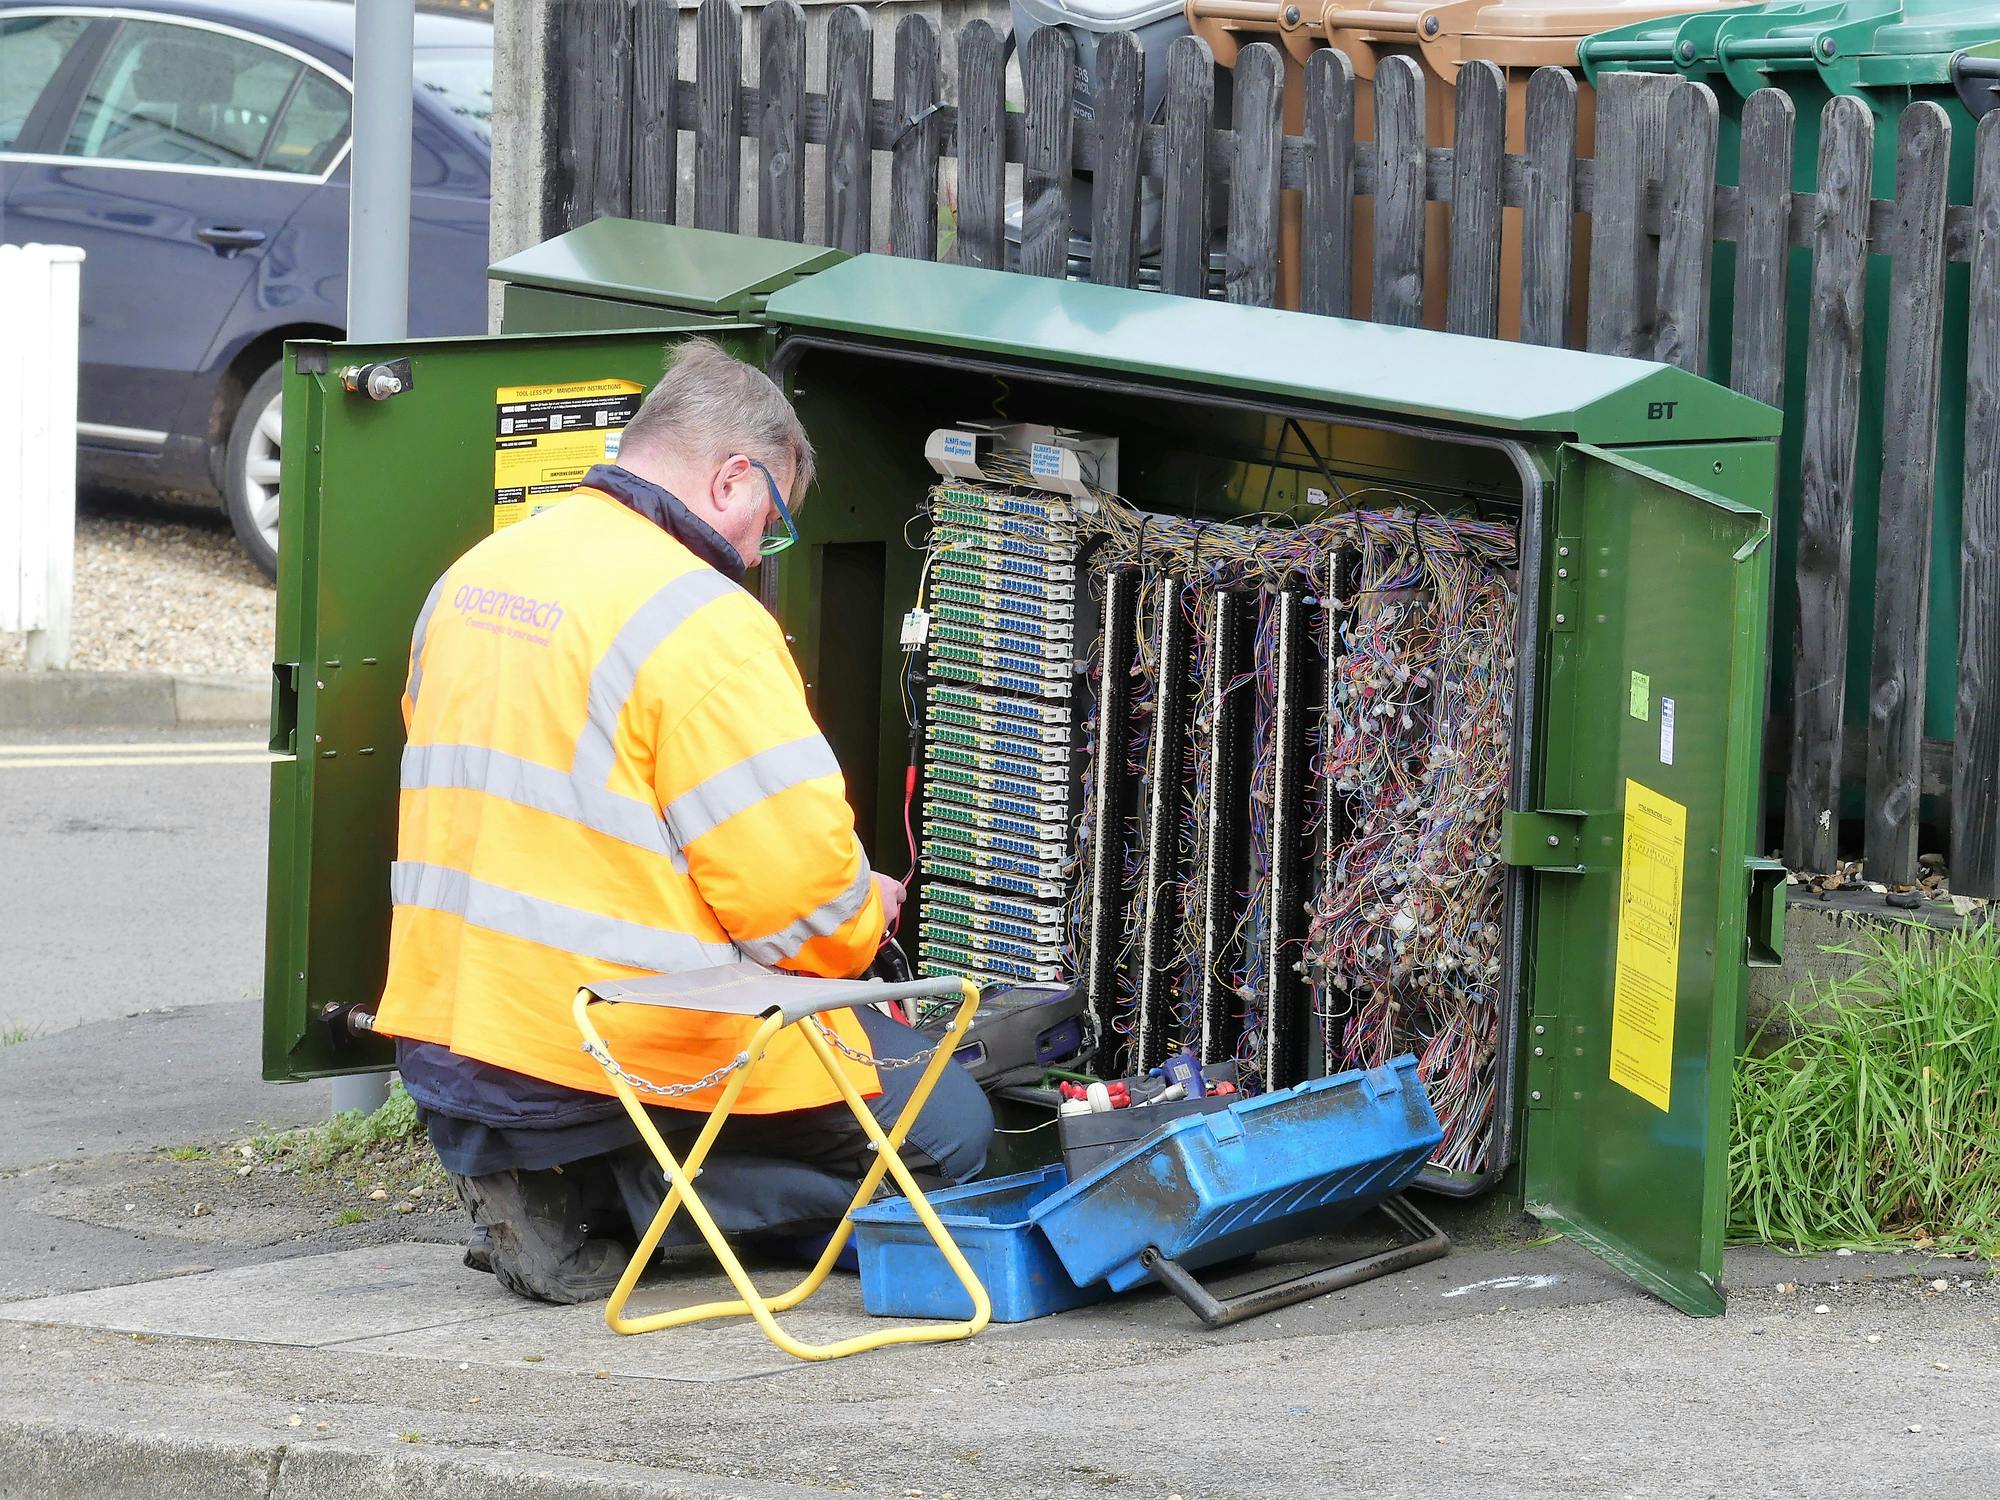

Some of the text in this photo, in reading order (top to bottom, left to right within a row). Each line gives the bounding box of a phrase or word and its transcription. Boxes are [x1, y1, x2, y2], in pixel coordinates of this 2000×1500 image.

[1073, 63, 1089, 83] ERS
[543, 388, 553, 396] PCP
[556, 386, 586, 394] MANDATORY
[1647, 401, 1679, 420] BT
[954, 446, 971, 456] jumpers
[454, 584, 565, 632] openreach
